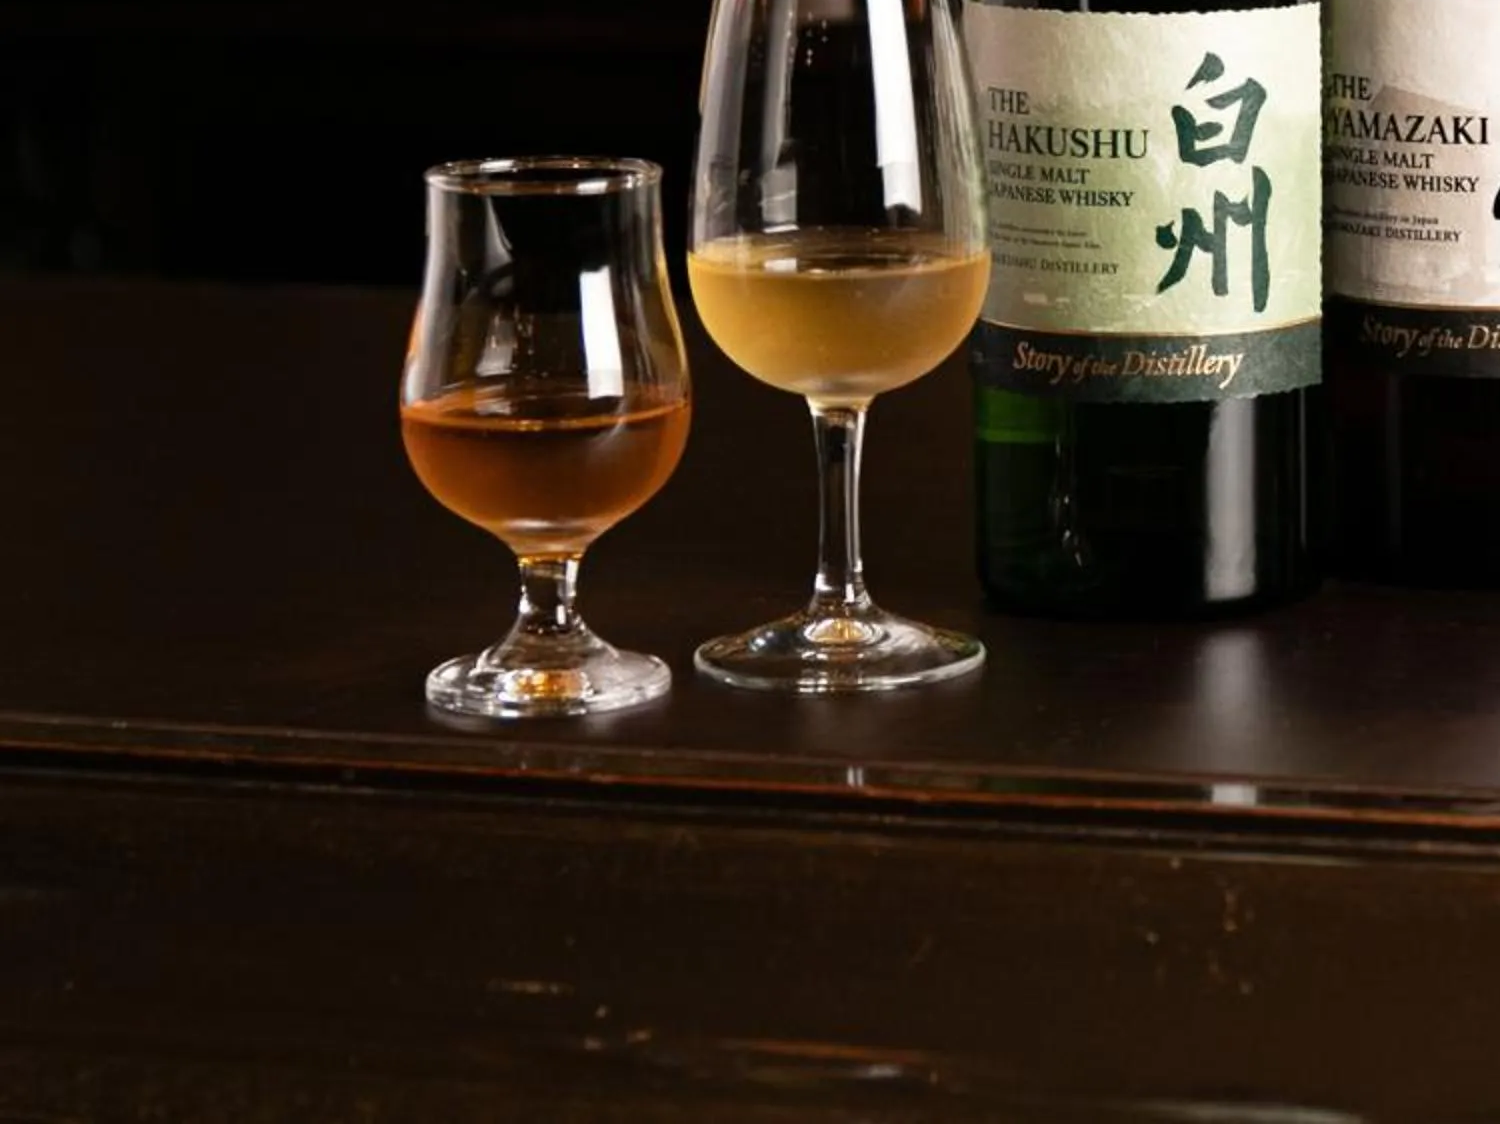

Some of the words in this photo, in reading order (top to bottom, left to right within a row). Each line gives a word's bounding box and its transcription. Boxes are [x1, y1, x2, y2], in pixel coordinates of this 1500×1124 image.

[988, 86, 1031, 115] THE
[1329, 73, 1371, 101] THE
[988, 120, 1150, 159] HAKUSHU
[1328, 107, 1489, 145] YAMAZAKI
[1383, 151, 1435, 169] MALT
[1040, 166, 1091, 185] MALT
[1155, 51, 1273, 313] 白州
[1404, 175, 1480, 193] WHISKY
[1059, 189, 1136, 207] WHISKY
[1438, 329, 1463, 350] the
[1013, 340, 1072, 384] Story
[1122, 343, 1245, 390] Distillery
